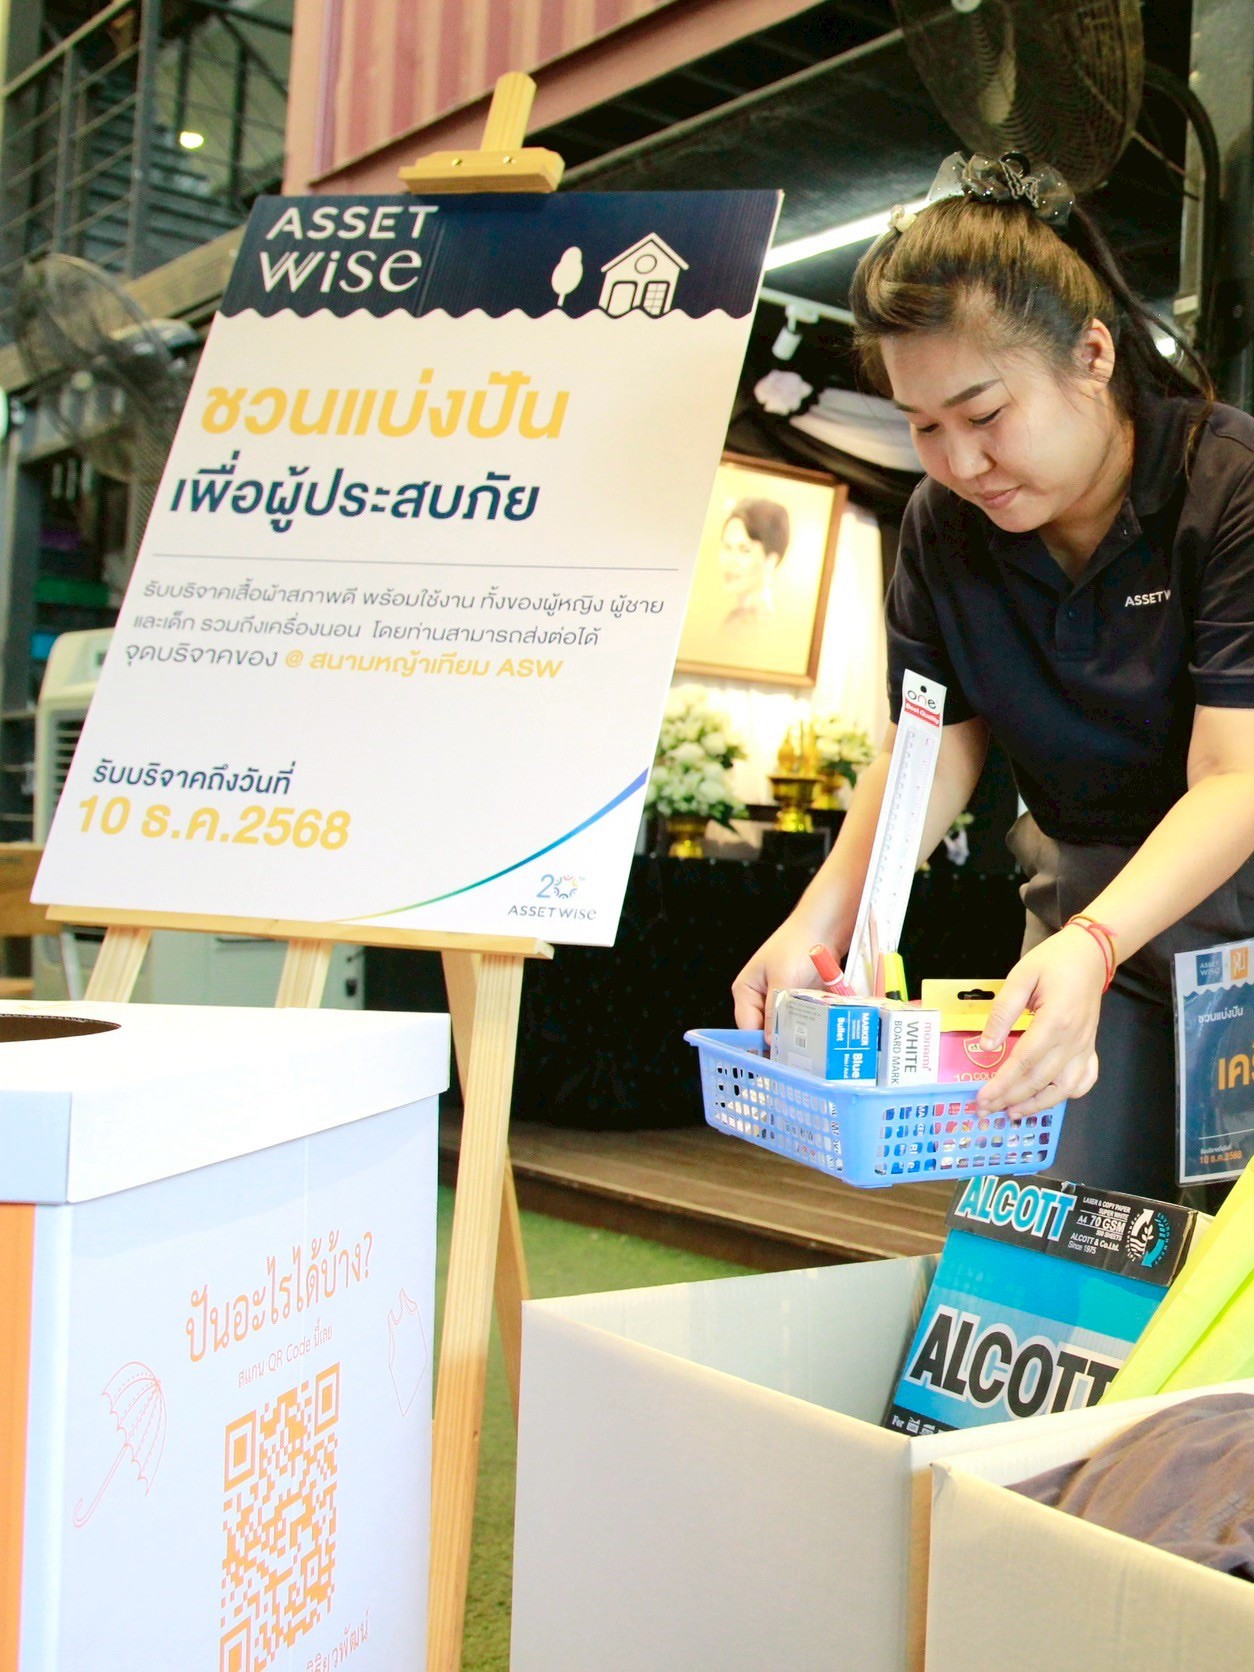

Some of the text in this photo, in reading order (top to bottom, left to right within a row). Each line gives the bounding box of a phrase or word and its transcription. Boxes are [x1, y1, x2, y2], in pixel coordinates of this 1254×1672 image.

[266, 204, 439, 239] ASSET
[200, 367, 571, 440] ชวนแบ่งปัน
[170, 450, 540, 532] เพื่อผู้ประสบภัย
[144, 578, 664, 618] รับบริจาคเสื้อผ้าสภาพดี พร้อมใช้งาน ทั้งของผู้หญิง ผู้ชาย
[134, 610, 195, 632] และเด็ก
[126, 642, 563, 678] จุดบริจาคของ @ สนามหญ้าเทียม ASW
[907, 690, 937, 710] one
[92, 759, 297, 795] รับบริจาคถึงวันที่
[78, 795, 351, 850] 10 ธ.ค.2568
[861, 1012, 870, 1046] MARKER
[1198, 1006, 1244, 1023] ชวนแบ่งปัน
[892, 1020, 902, 1054] BOARD
[904, 1021, 919, 1073] WHITE
[851, 1053, 863, 1079] Blue
[954, 1175, 1077, 1241] ALCOTT
[1078, 1215, 1126, 1233] A4 70 GSM
[1068, 1241, 1097, 1254] Since 1975
[1070, 1232, 1095, 1245] ALCOTT
[186, 1230, 373, 1363] ปันอะไรได้บ้าง?
[268, 1349, 283, 1372] QR
[286, 1336, 311, 1363] Code
